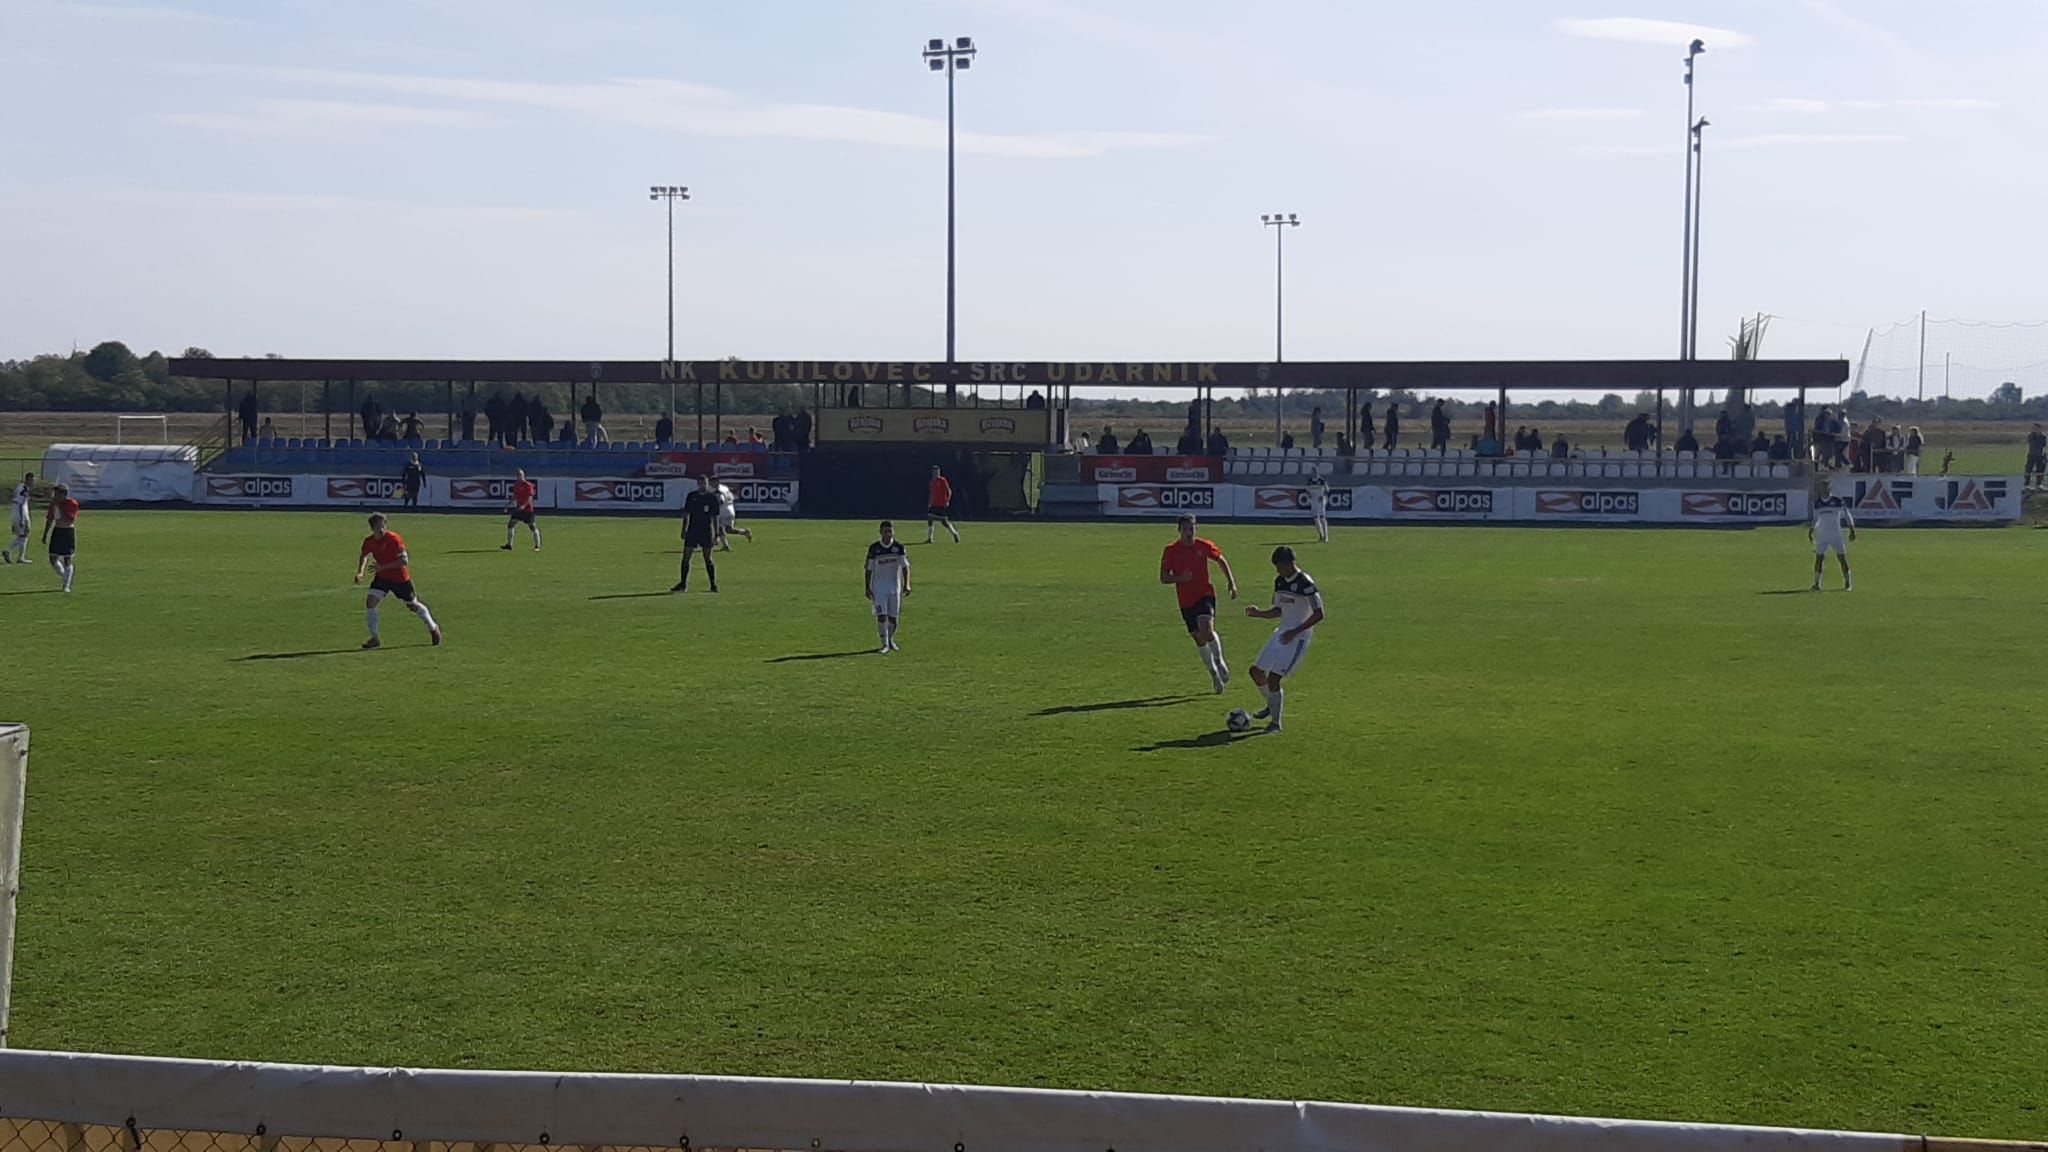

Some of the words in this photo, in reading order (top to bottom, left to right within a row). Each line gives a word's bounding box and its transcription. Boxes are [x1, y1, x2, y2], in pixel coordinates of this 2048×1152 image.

[660, 362, 696, 380] NK
[719, 362, 931, 381] KURILOVEC
[970, 363, 1027, 381] SRC
[1047, 362, 1218, 382] UDARNIK
[244, 477, 291, 496] alpas
[366, 478, 405, 498] alp
[614, 482, 662, 501] alpas
[740, 482, 790, 503] alpas
[1935, 478, 2007, 509] JAF
[1160, 487, 1213, 508] alpas
[1298, 491, 1351, 508] aas
[1436, 490, 1491, 511] alpas
[1581, 492, 1637, 513] alpas
[1728, 494, 1785, 515] alpas
